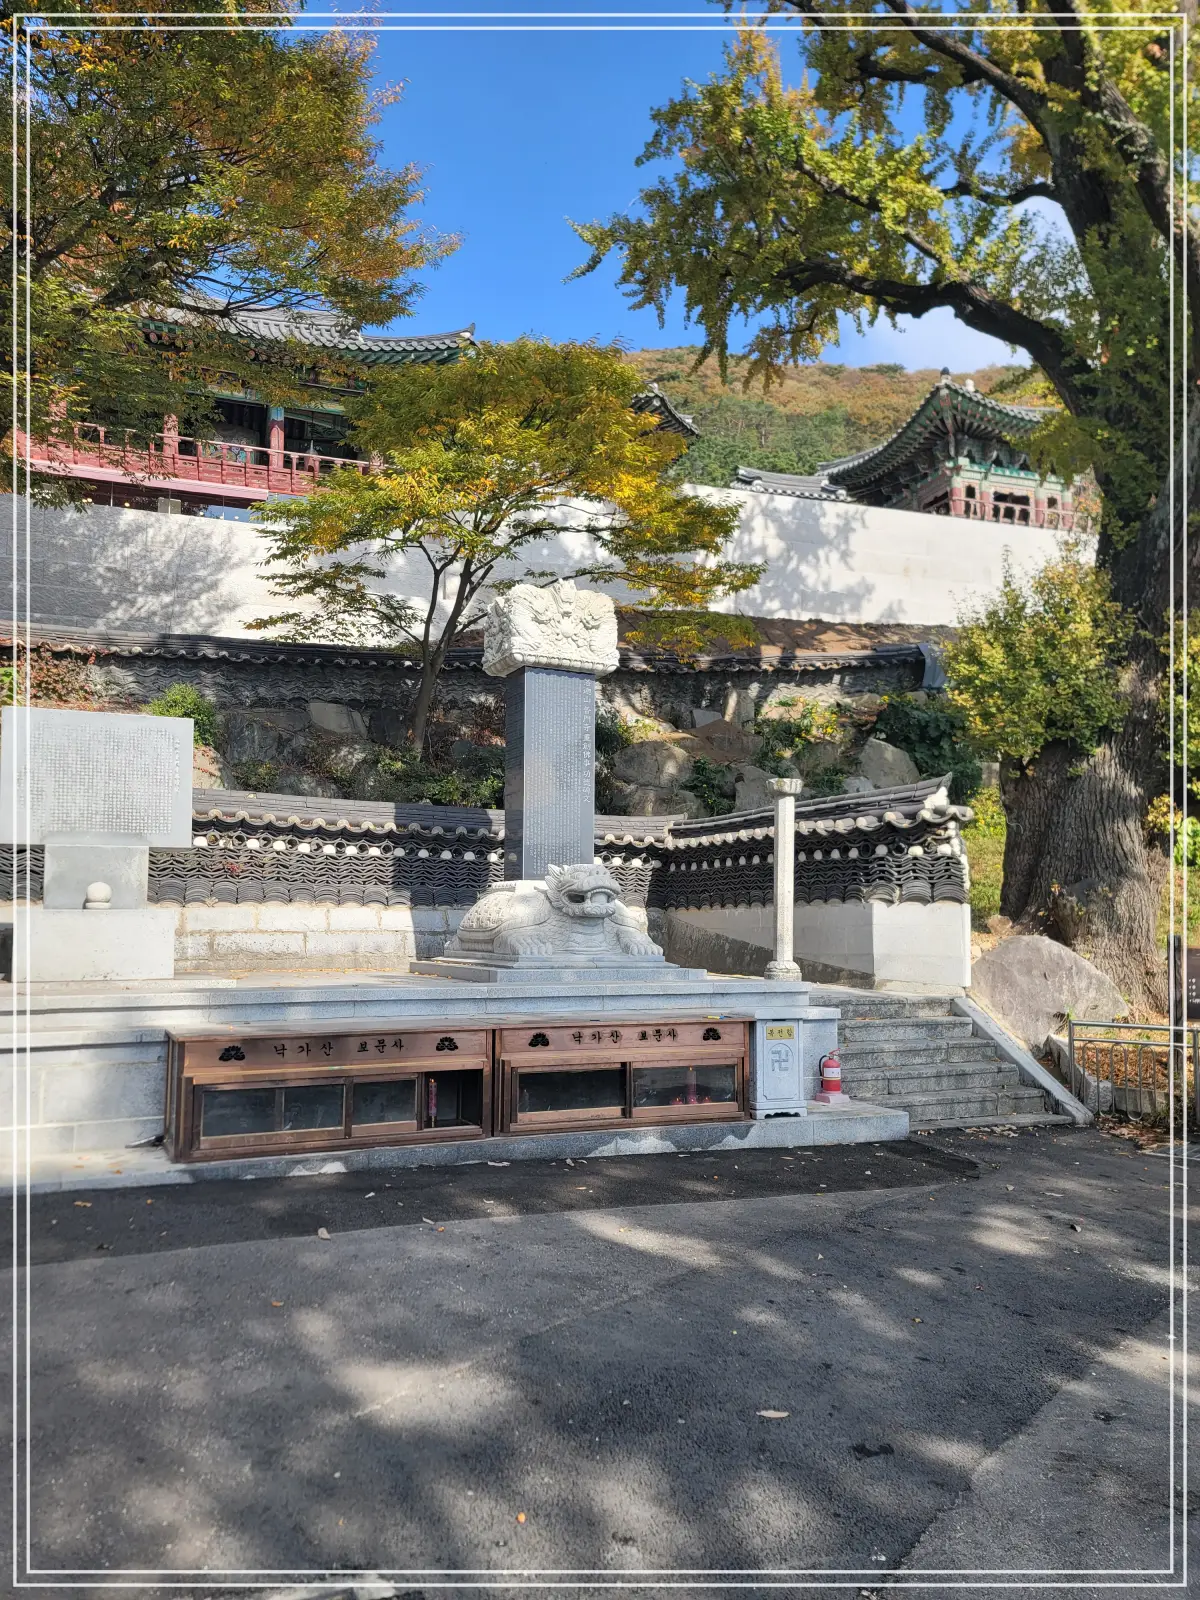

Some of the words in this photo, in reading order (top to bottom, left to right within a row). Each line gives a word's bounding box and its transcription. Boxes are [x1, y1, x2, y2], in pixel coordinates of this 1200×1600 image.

[571, 1029, 620, 1045] 낙가산
[638, 1027, 677, 1043] 보문사
[273, 1042, 334, 1058] 낙가산
[357, 1038, 405, 1054] 보문사
